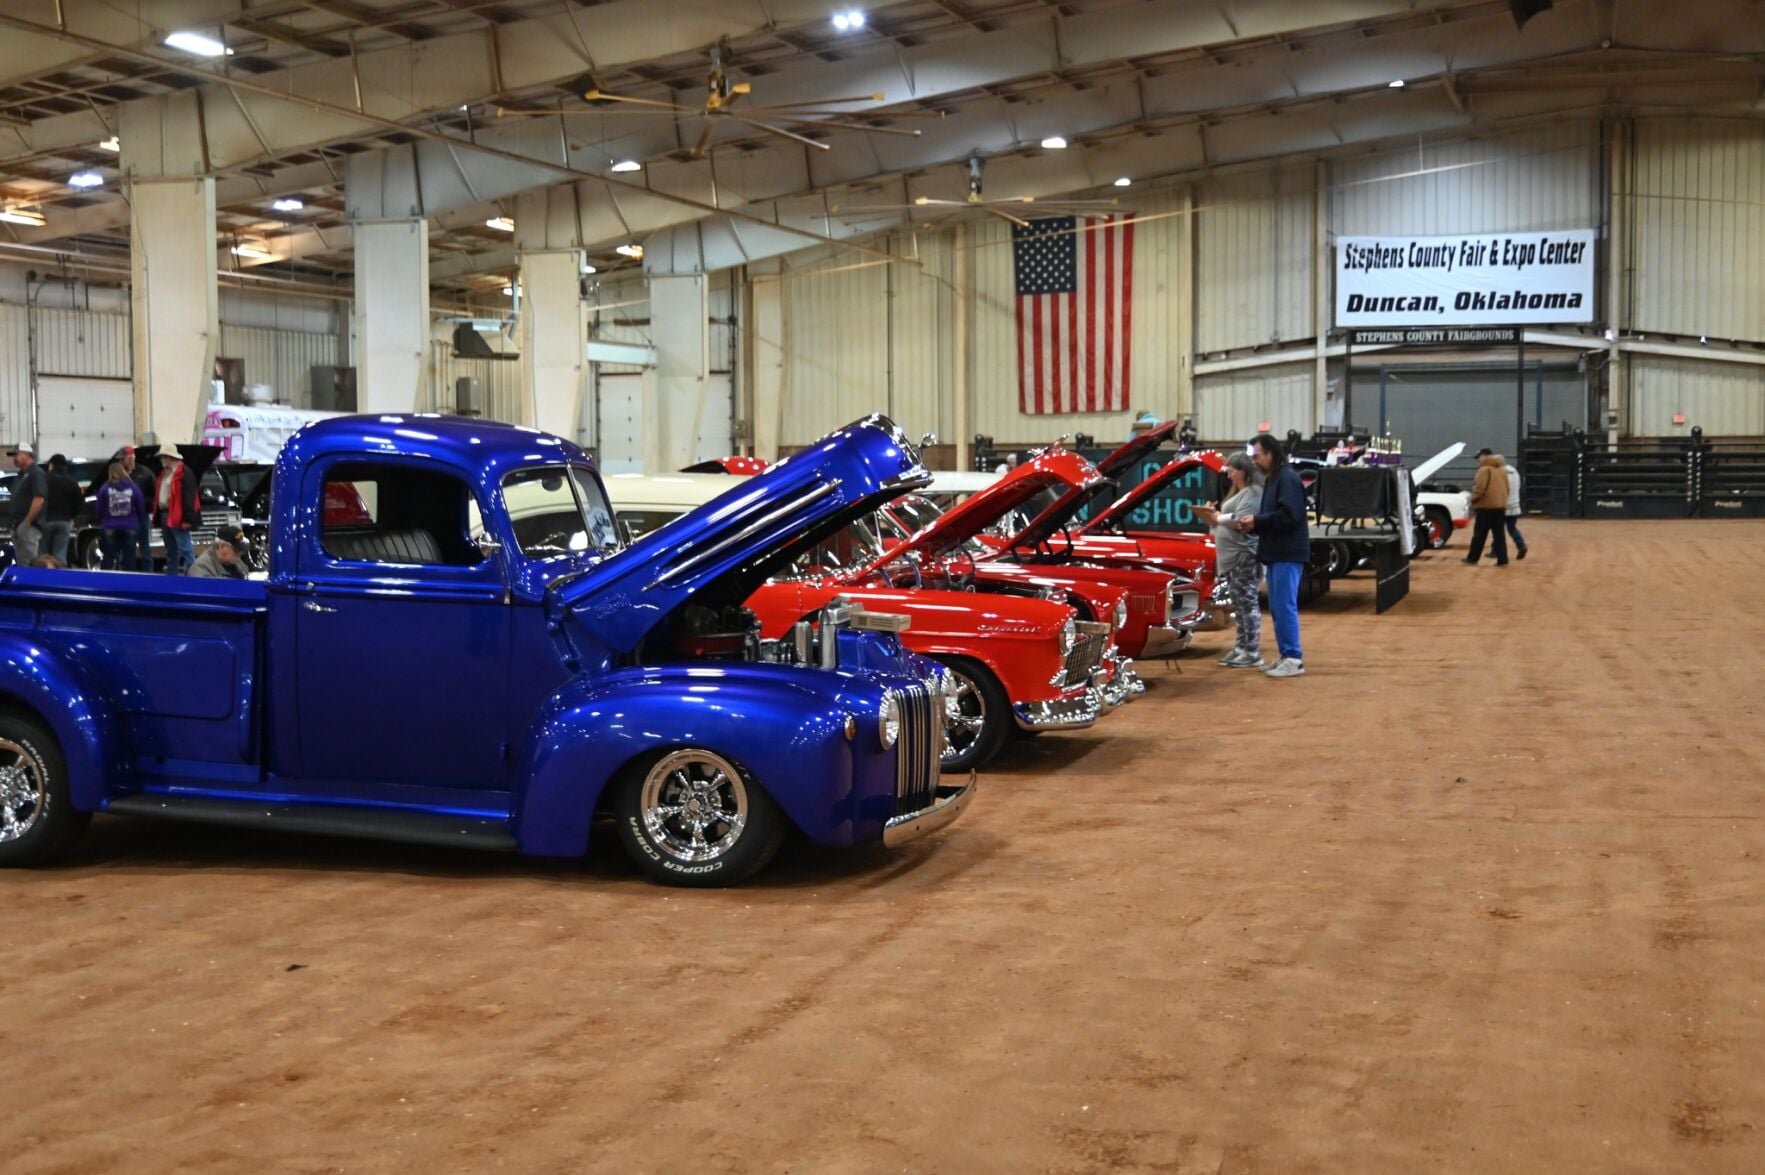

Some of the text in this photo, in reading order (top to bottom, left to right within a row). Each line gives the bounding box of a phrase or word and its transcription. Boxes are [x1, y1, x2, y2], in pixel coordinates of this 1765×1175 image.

[1344, 238, 1586, 274] Stephens County Fair & Expo Center
[1346, 290, 1583, 314] Duncan, Oklahoma
[1355, 330, 1514, 343] STEPHENS COUNTY FAIRGROUNDS
[1132, 498, 1207, 525] SHO
[629, 816, 723, 874] COOPER COBRA
